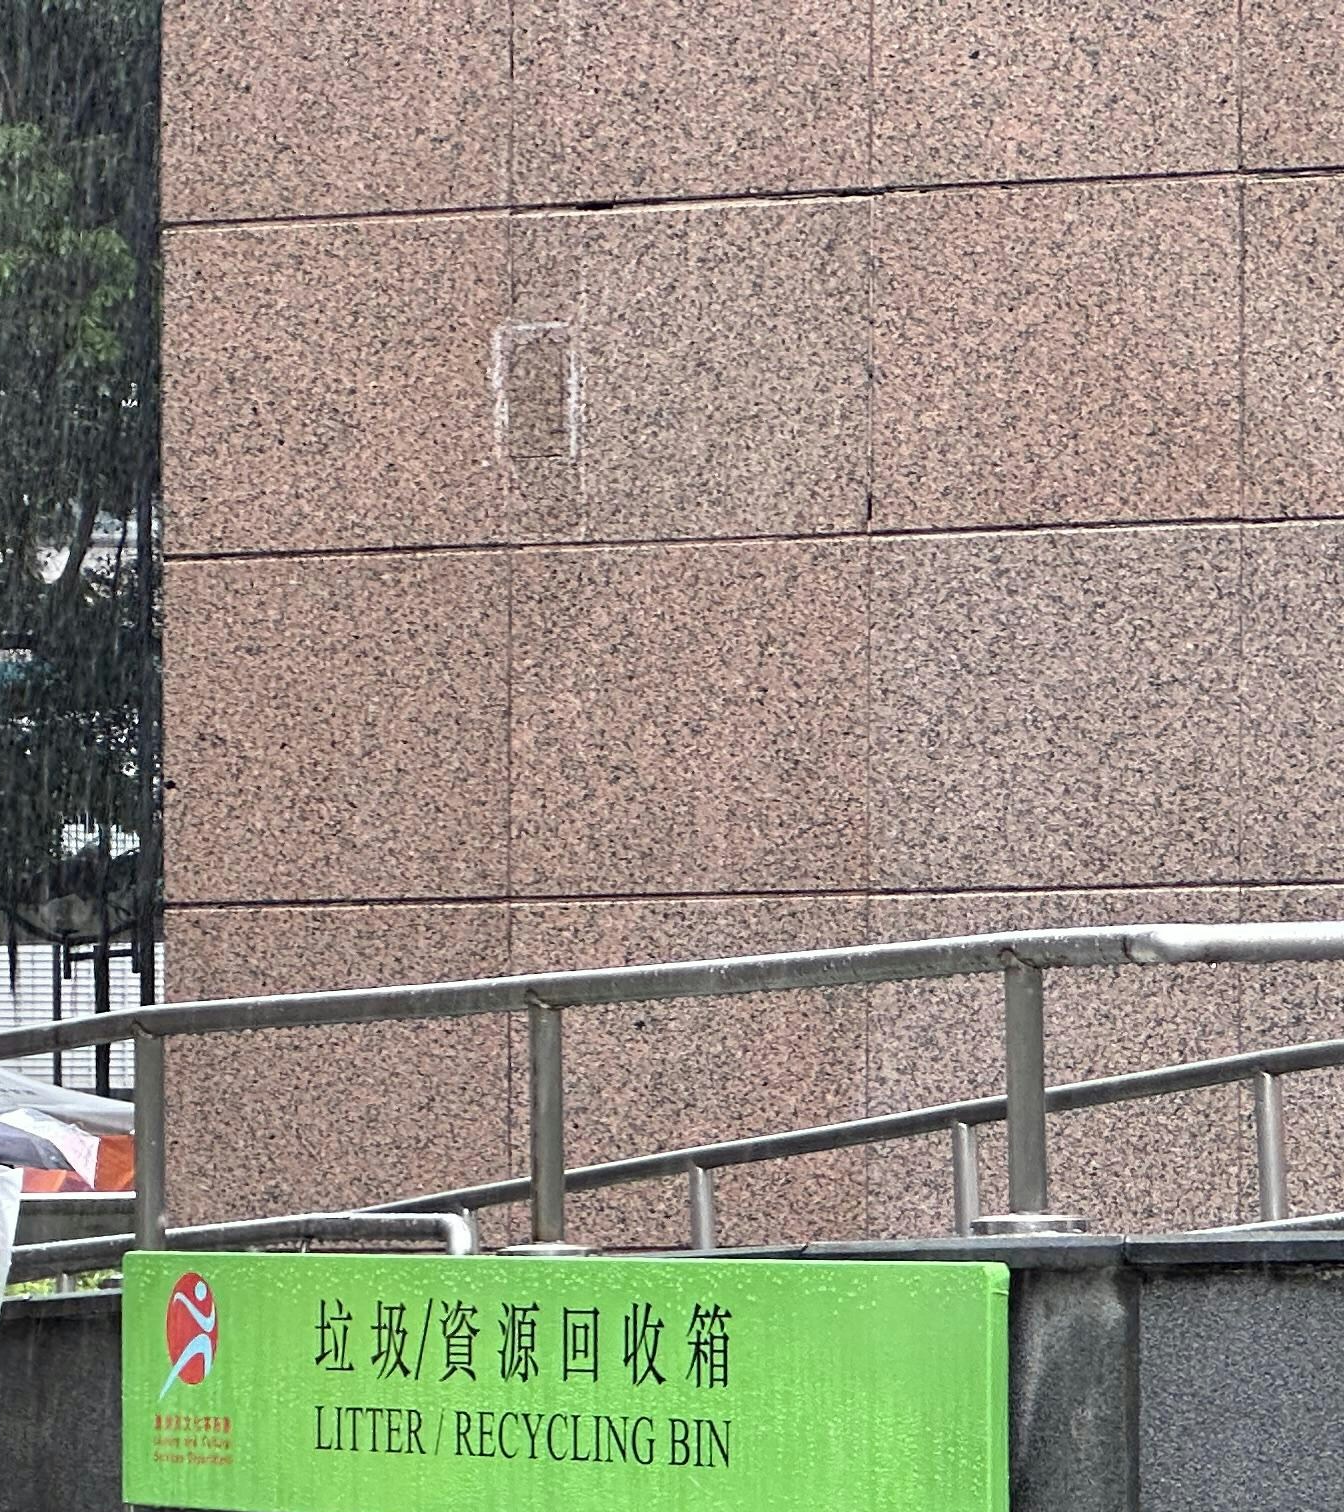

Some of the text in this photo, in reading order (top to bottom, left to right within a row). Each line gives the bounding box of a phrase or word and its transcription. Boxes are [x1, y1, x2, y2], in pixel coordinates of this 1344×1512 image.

[314, 1297, 732, 1389] 垃圾/資源回收箱
[315, 1405, 427, 1455] LITTER
[454, 1409, 656, 1466] RECYCLING
[668, 1417, 732, 1469] BIN
